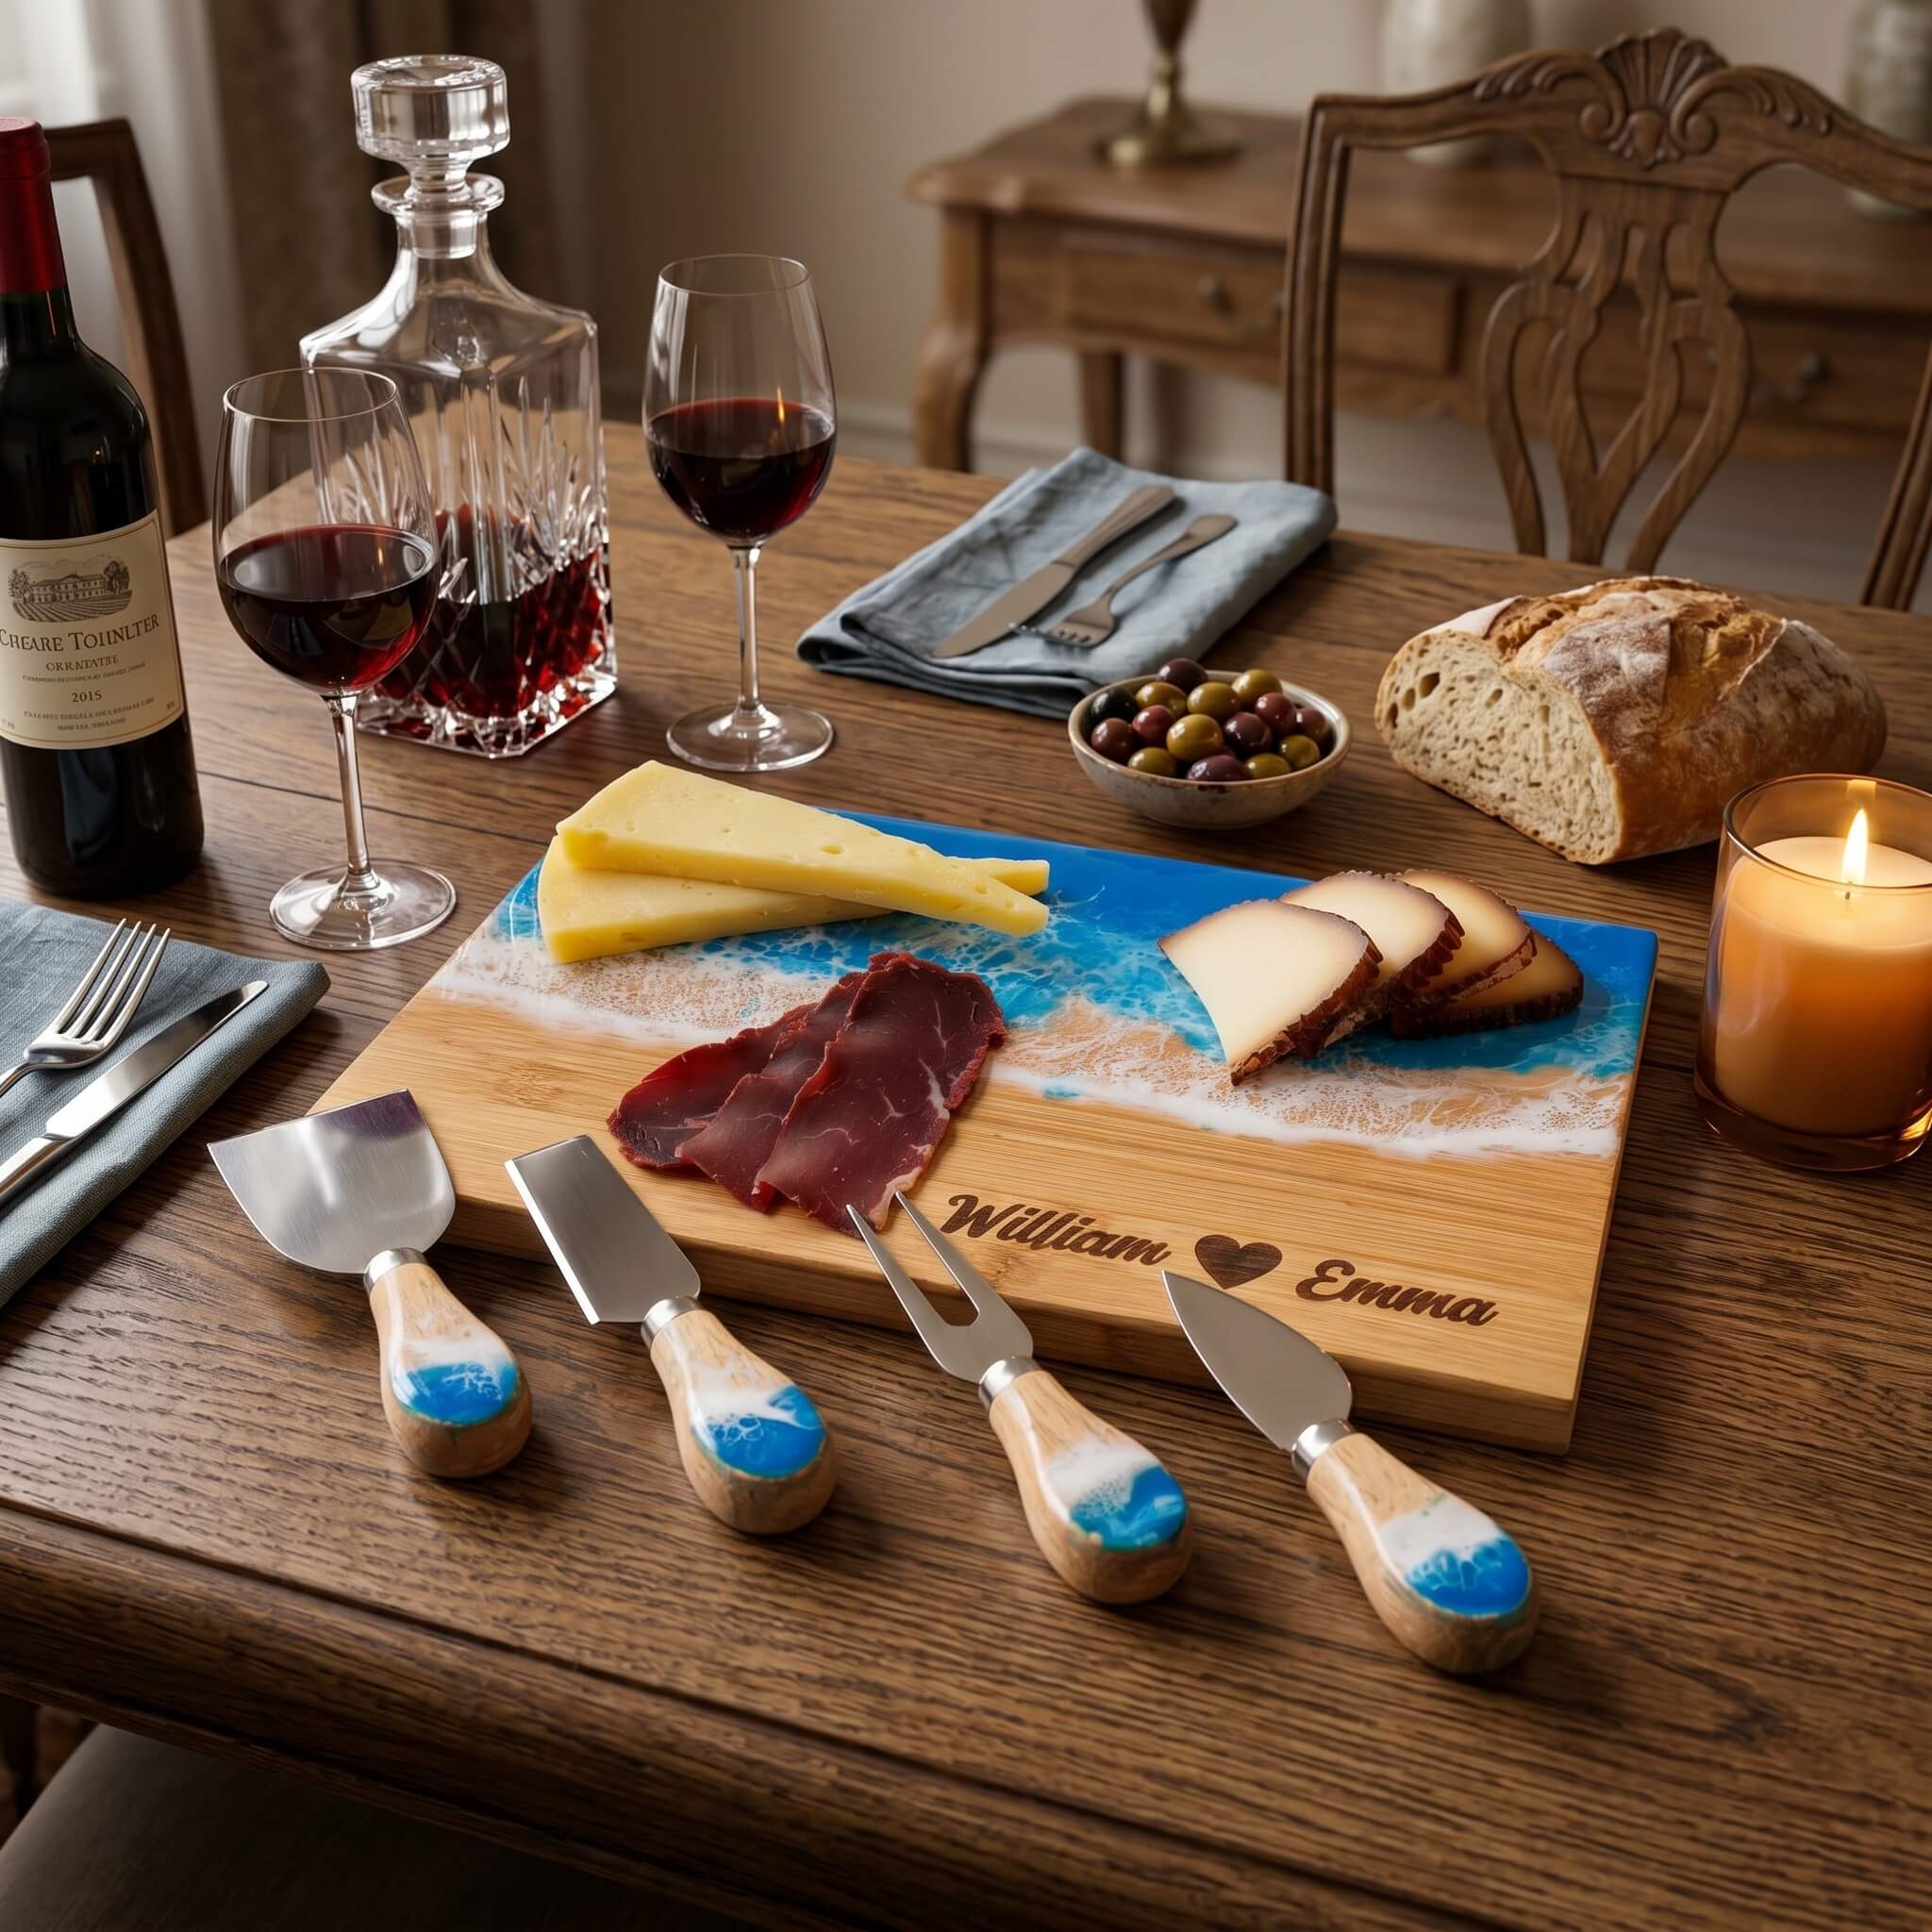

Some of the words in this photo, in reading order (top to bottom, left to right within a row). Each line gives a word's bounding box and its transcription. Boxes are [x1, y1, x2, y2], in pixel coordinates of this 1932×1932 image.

[72, 690, 102, 703] 2015
[940, 1194, 1172, 1266] William
[1295, 1259, 1499, 1326] Emma
